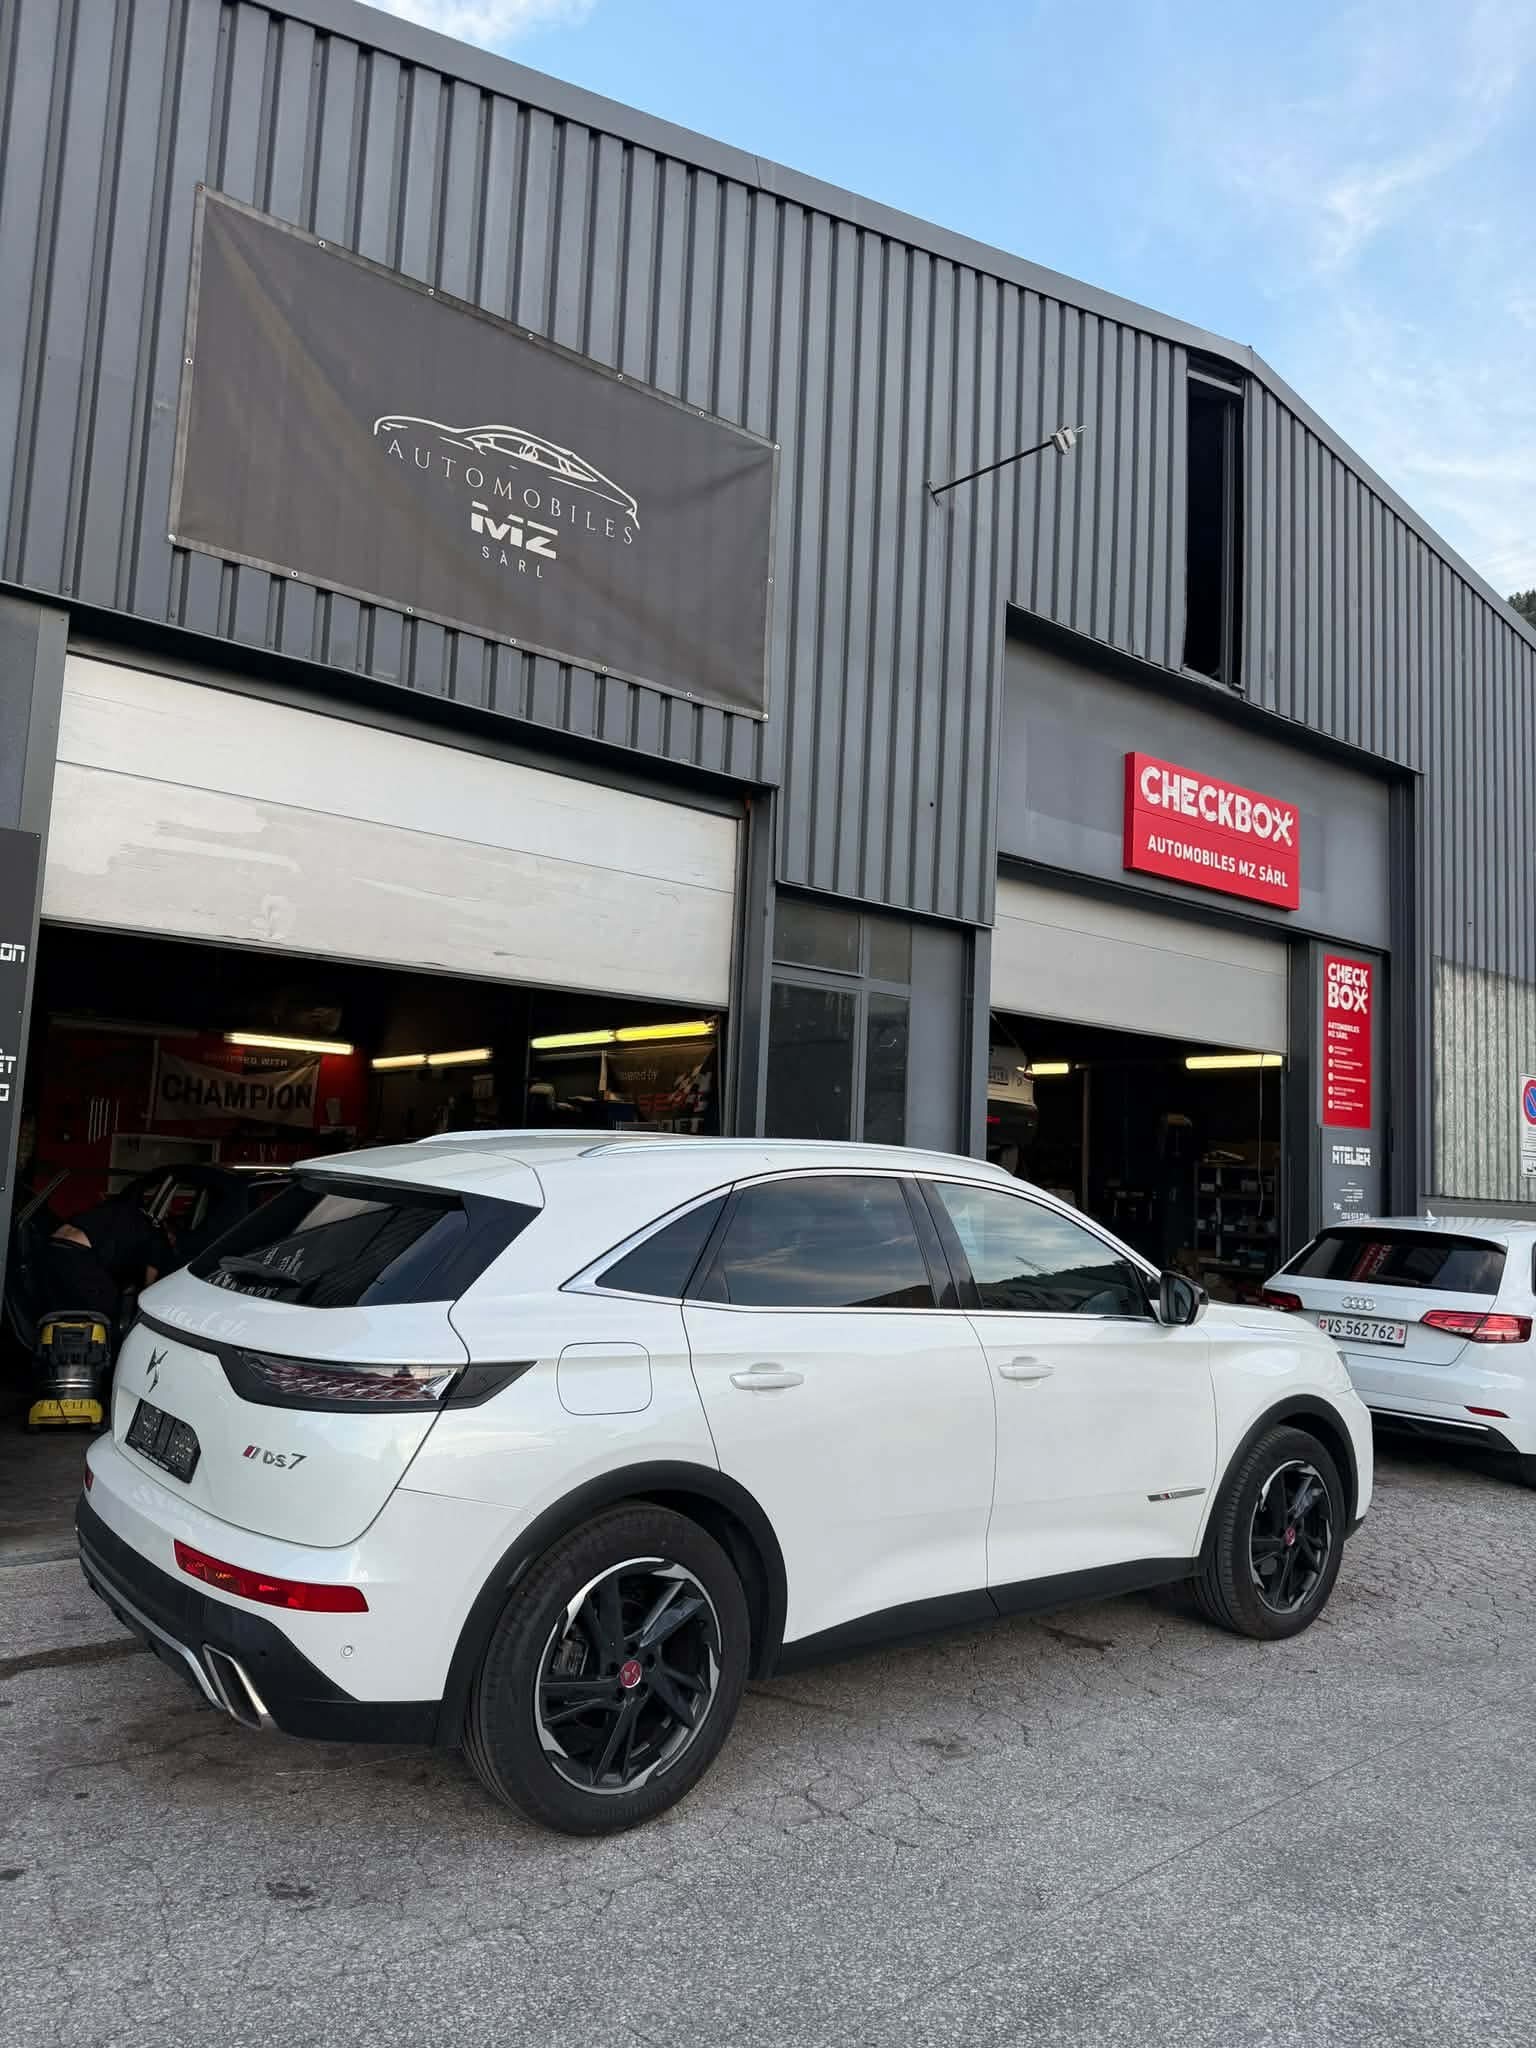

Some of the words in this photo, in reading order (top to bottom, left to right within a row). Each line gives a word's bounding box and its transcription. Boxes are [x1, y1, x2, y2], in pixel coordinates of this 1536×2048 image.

[388, 439, 633, 545] AUTOMOBILES
[471, 501, 559, 560] MZ
[481, 546, 543, 579] SÀRL
[1140, 766, 1294, 847] CHECKBOX
[1147, 834, 1236, 873] AUTOMOBILES
[1239, 860, 1256, 879] MZ
[1259, 864, 1289, 888] SÀRL
[1327, 962, 1369, 989] CHECK
[1327, 981, 1369, 1014] BOX
[162, 1074, 312, 1110] CHAMPION
